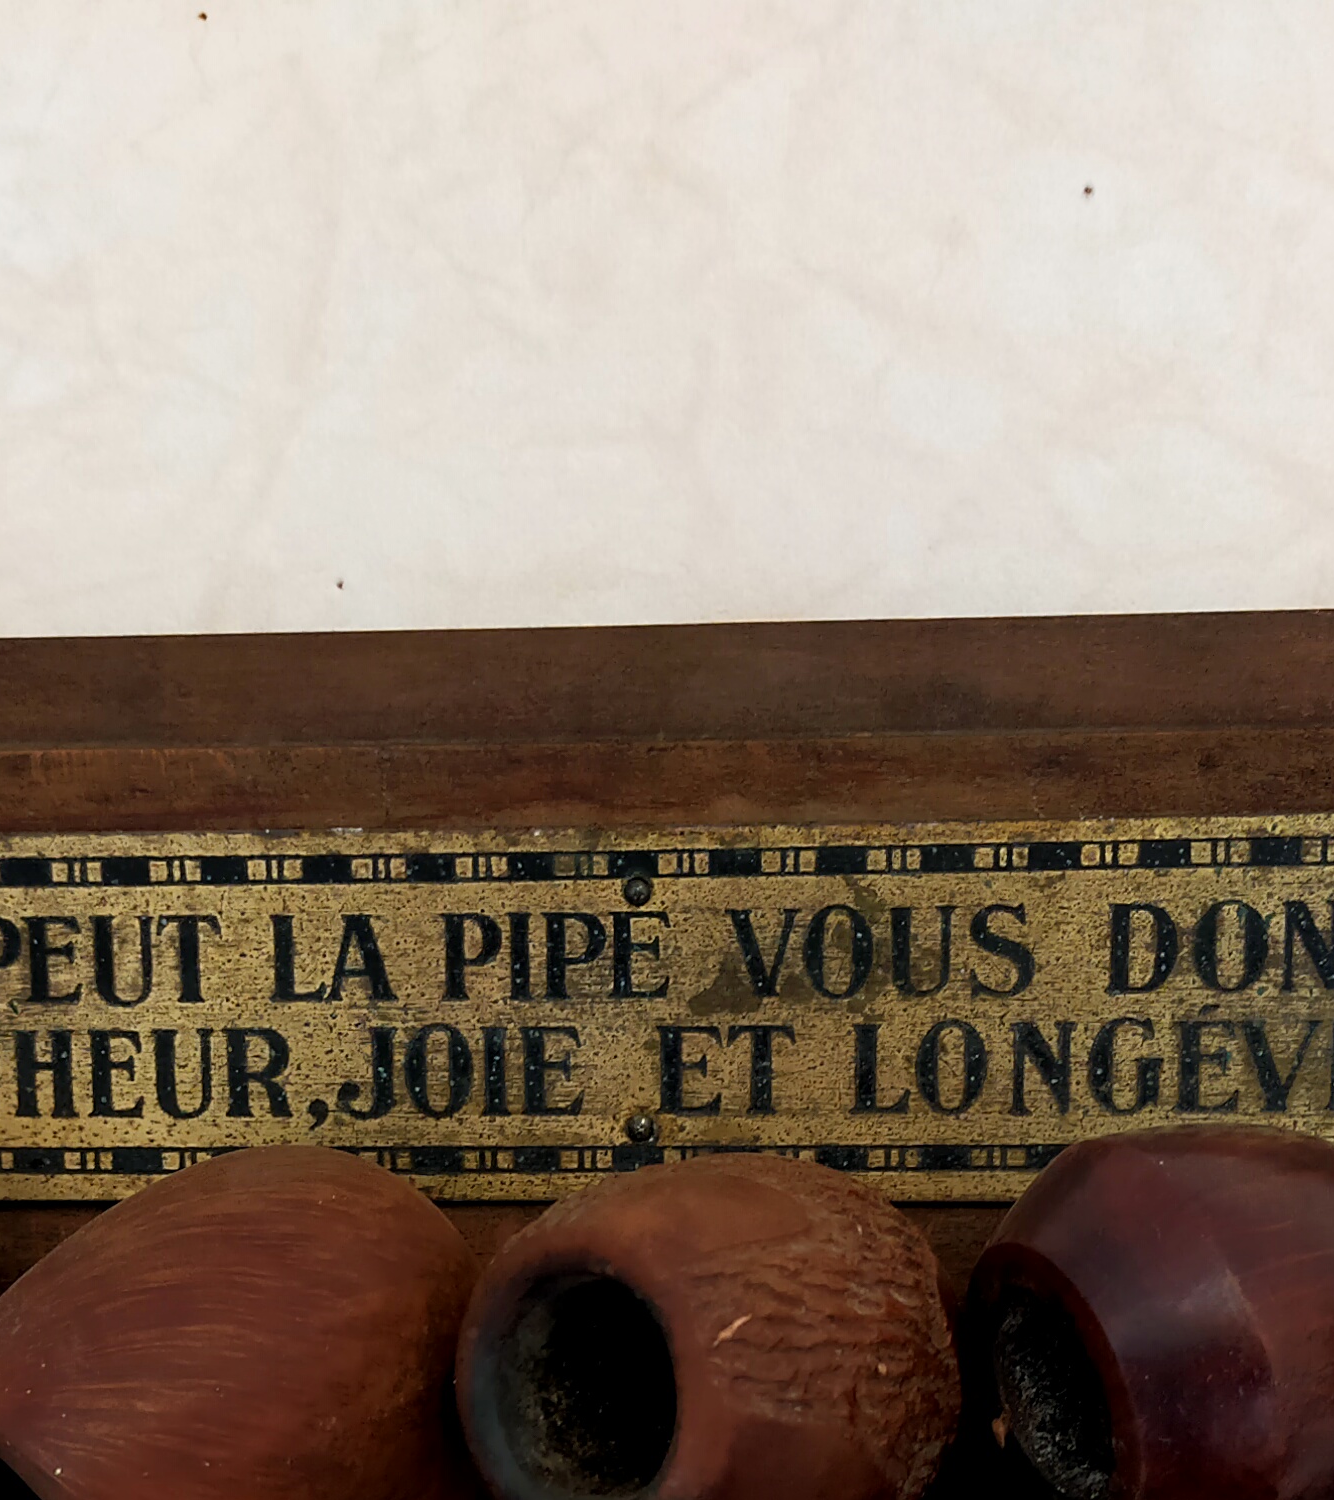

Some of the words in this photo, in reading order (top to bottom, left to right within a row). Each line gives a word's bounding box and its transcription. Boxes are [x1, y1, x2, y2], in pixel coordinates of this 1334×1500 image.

[269, 913, 399, 1001] LA
[441, 910, 671, 1001] PIPE
[724, 902, 1037, 999] VOUS
[656, 1023, 797, 1116] ET
